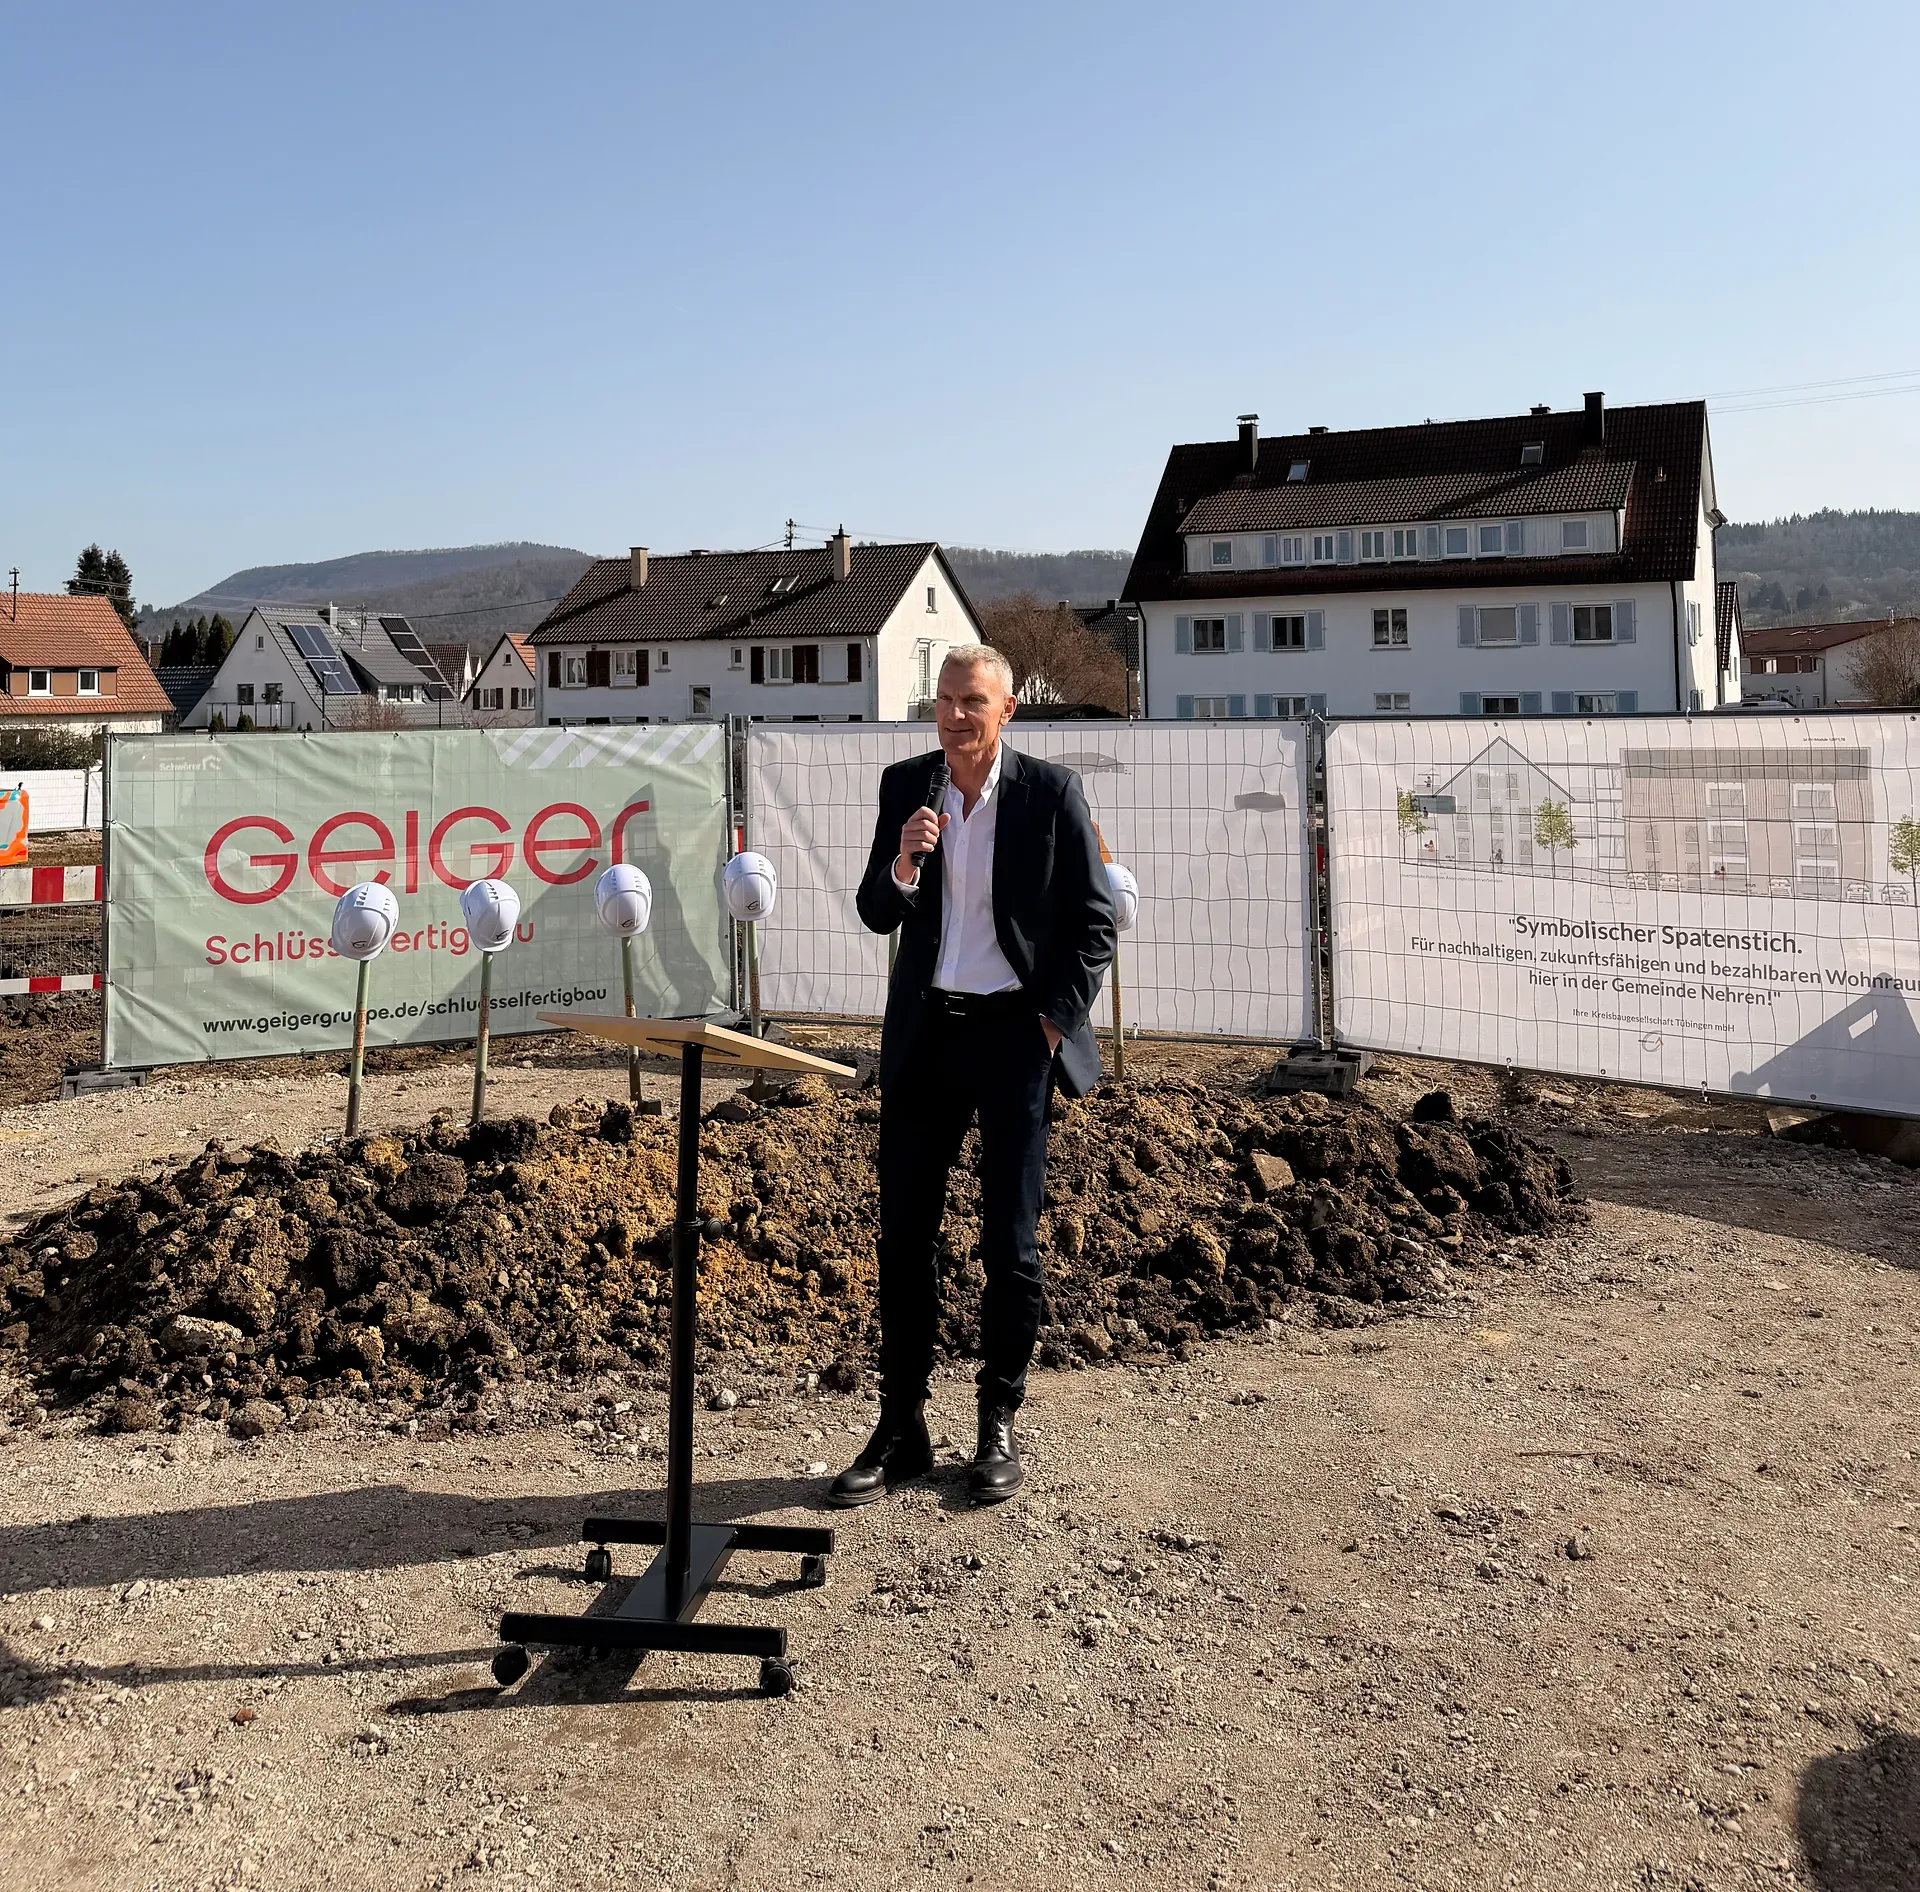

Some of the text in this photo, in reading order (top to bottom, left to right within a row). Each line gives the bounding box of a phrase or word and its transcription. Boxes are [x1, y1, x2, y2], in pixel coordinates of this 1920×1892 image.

[1508, 916, 1803, 954] "Symbolischer Spatenstich.
[1411, 936, 1920, 992] Für nachhaltigen, zukunftsfähigen und bezahlbaren Wohnrau
[1529, 970, 1781, 1006] hier in der Gemeinde Nehren!"
[1572, 1008, 1735, 1032] Ihre Kreisbaugesellschaft Tübingen mbH
